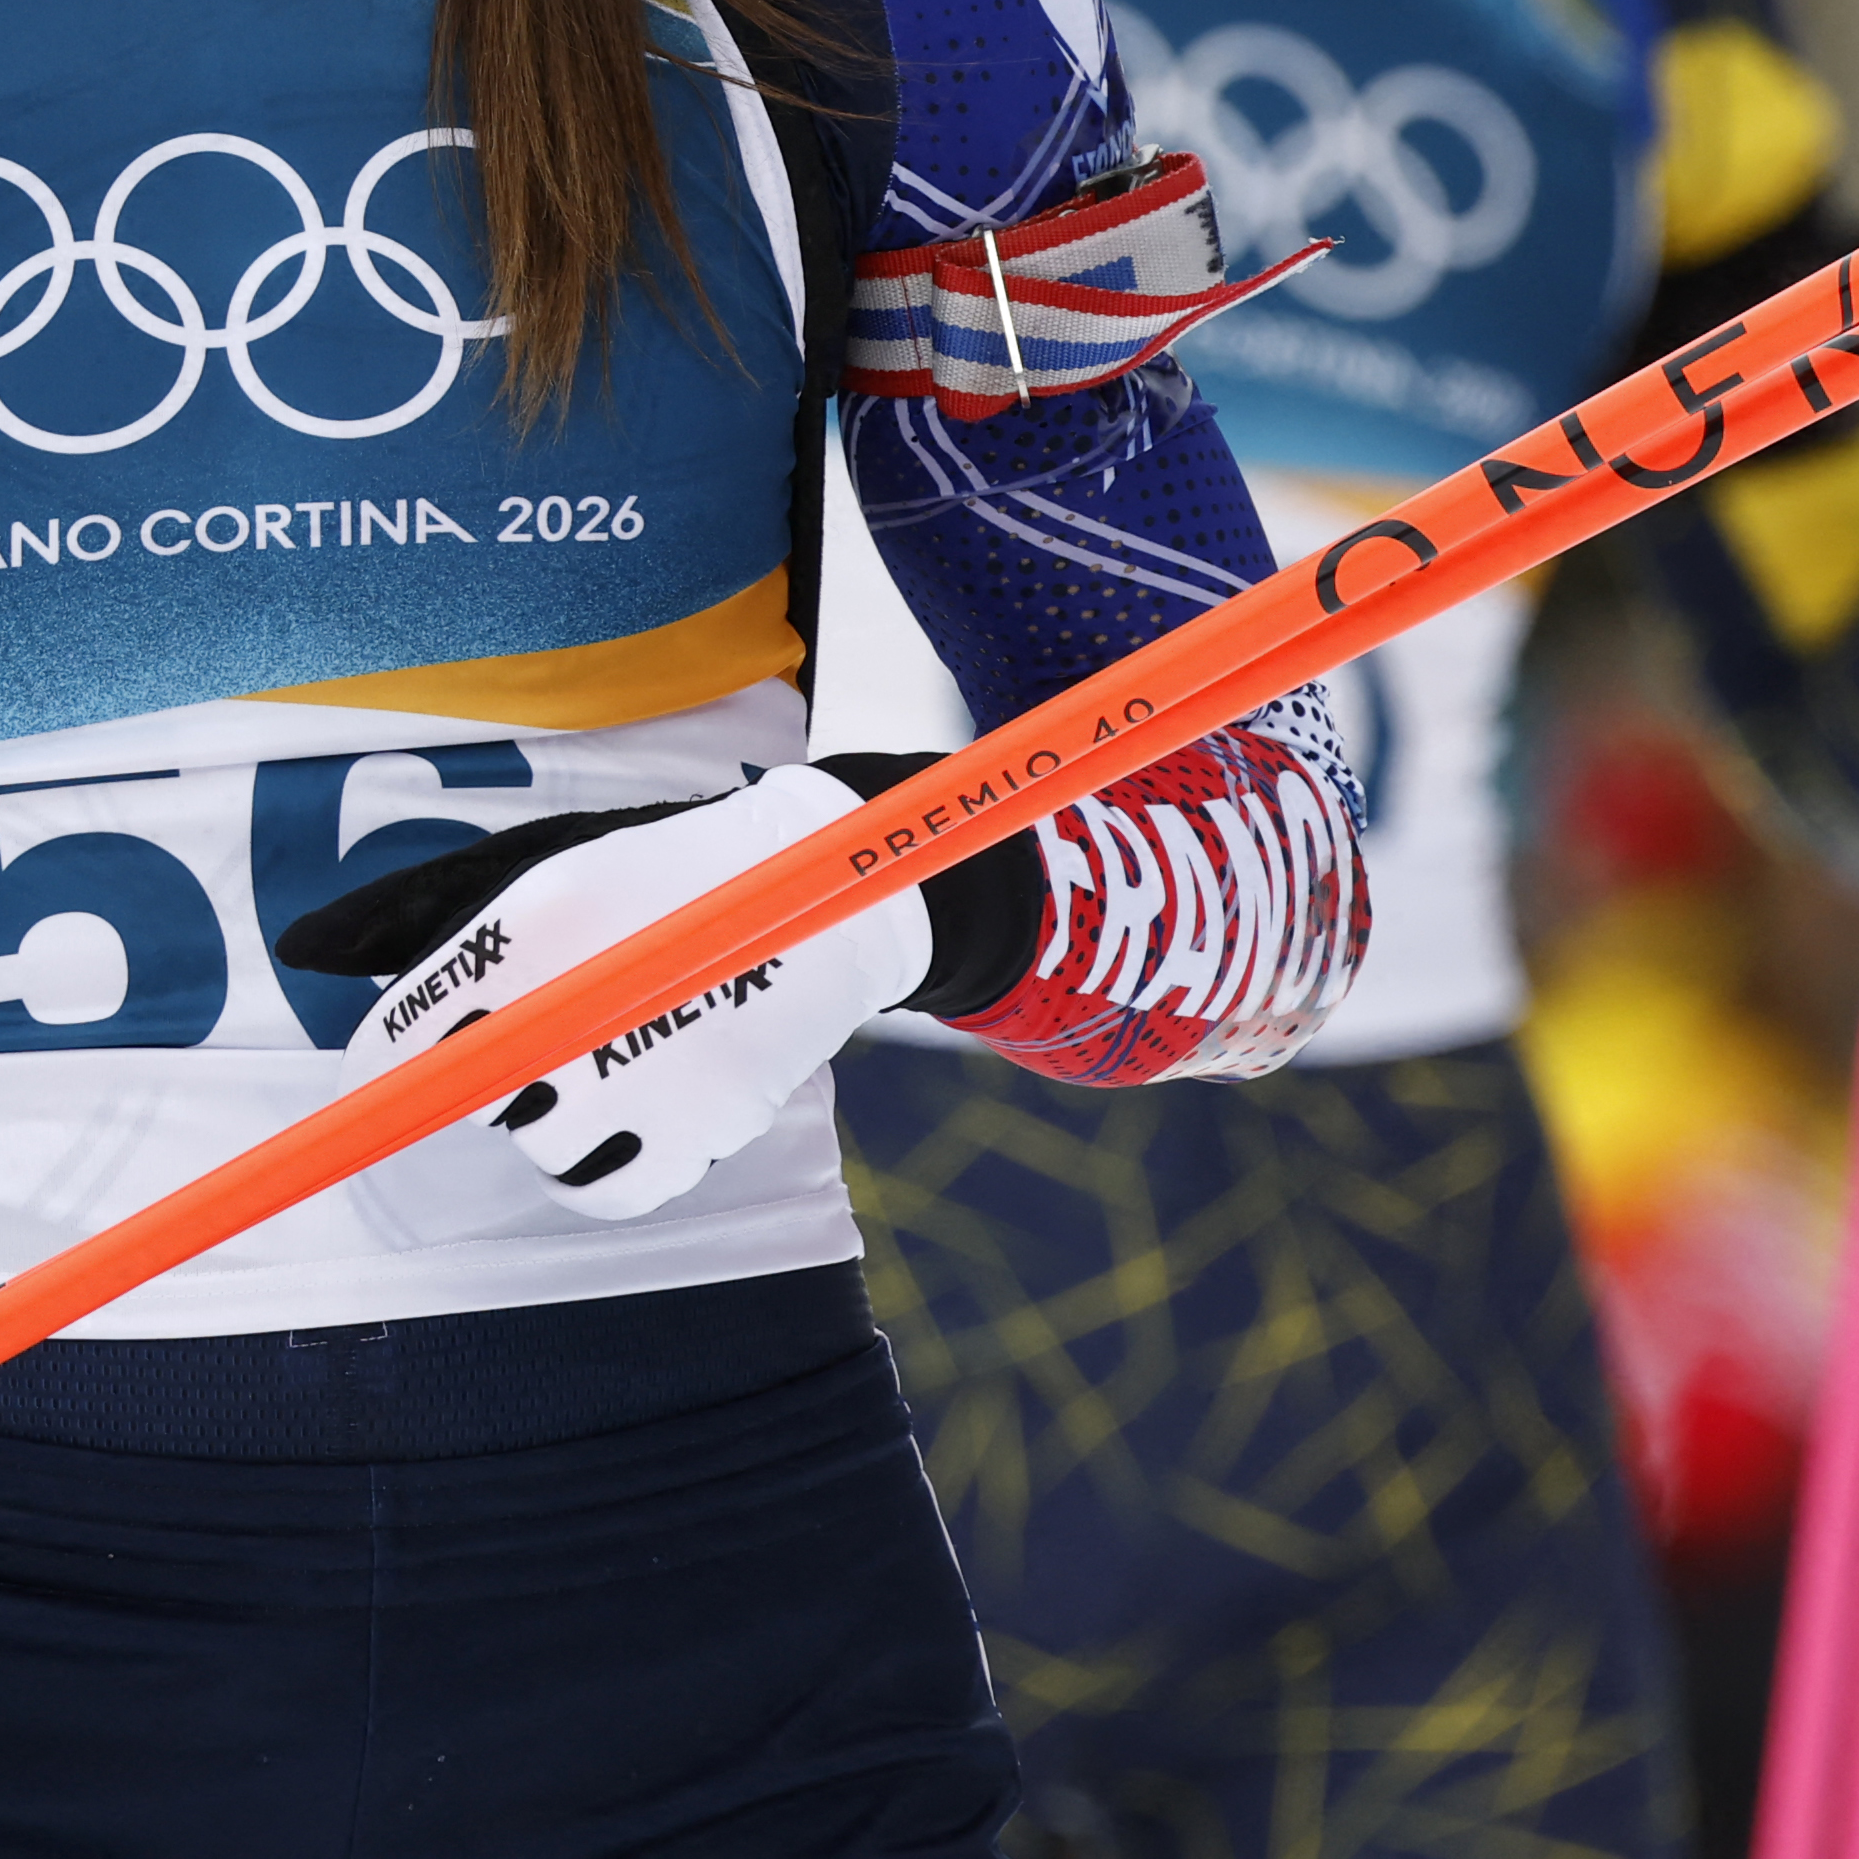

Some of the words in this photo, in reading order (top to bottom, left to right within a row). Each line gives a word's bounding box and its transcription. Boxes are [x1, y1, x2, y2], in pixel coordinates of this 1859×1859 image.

[140, 497, 478, 556] CORTINA
[496, 495, 645, 542] 2026
[848, 749, 1062, 877] PREMIO
[1092, 697, 1156, 744] 40
